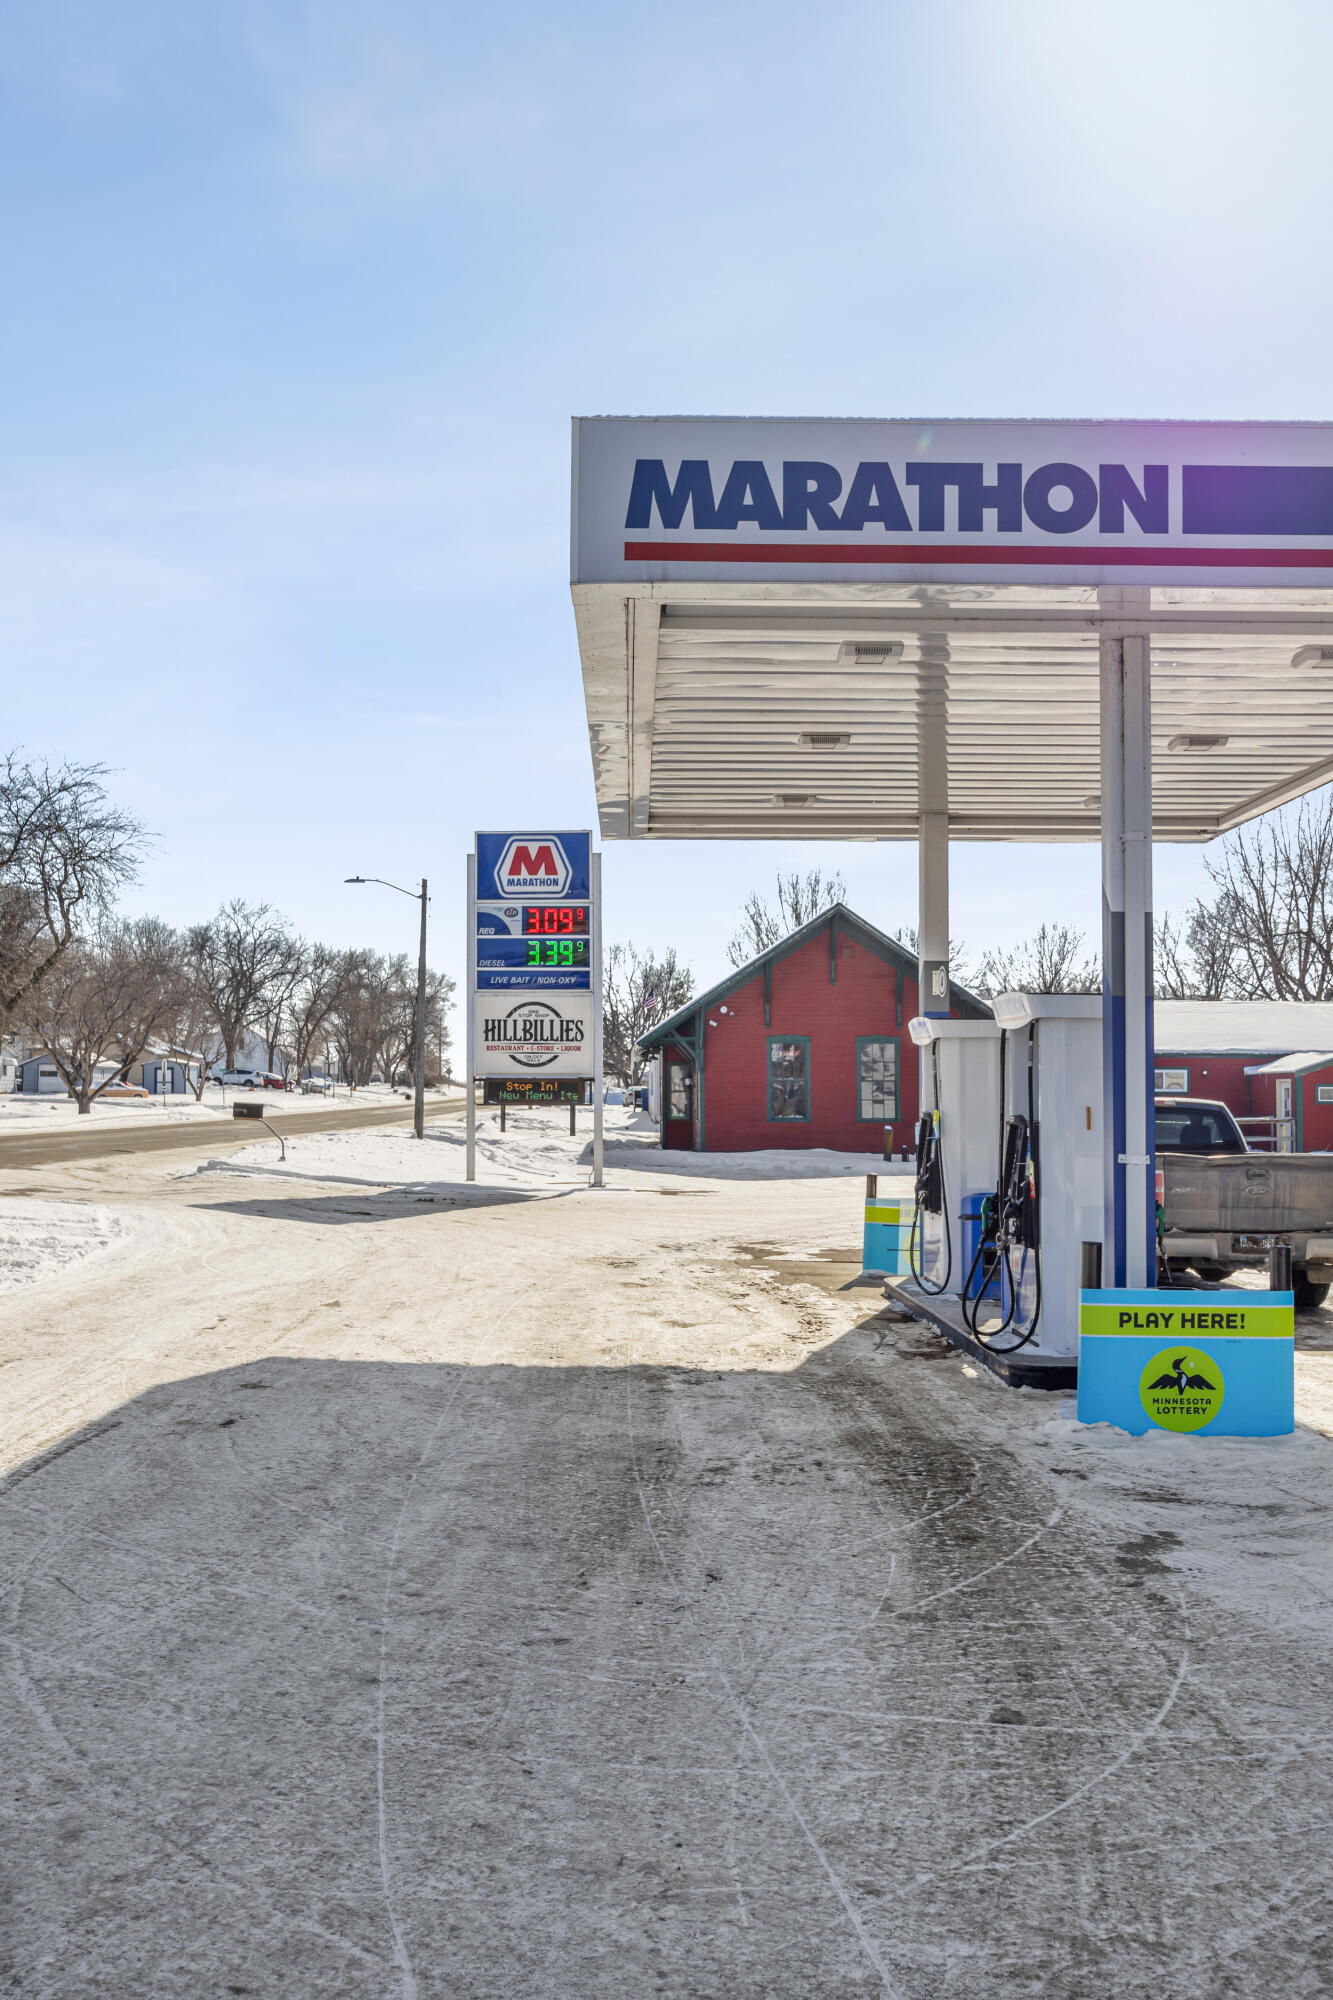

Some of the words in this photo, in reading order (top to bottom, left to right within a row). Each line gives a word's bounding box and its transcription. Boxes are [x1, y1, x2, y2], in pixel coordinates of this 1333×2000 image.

[624, 458, 1169, 535] MARATHON
[506, 878, 559, 887] MARATHON
[483, 1019, 585, 1042] HILLBILLIES
[506, 1081, 533, 1091] Stop
[540, 1081, 558, 1091] In!
[499, 1091, 520, 1100] New
[526, 1091, 553, 1100] Menu
[560, 1091, 579, 1100] Ite
[1118, 1312, 1174, 1329] PLAY
[1180, 1313, 1245, 1330] HERE!
[1152, 1397, 1212, 1405] MINNESOTA
[1156, 1406, 1208, 1415] LOTTERY
